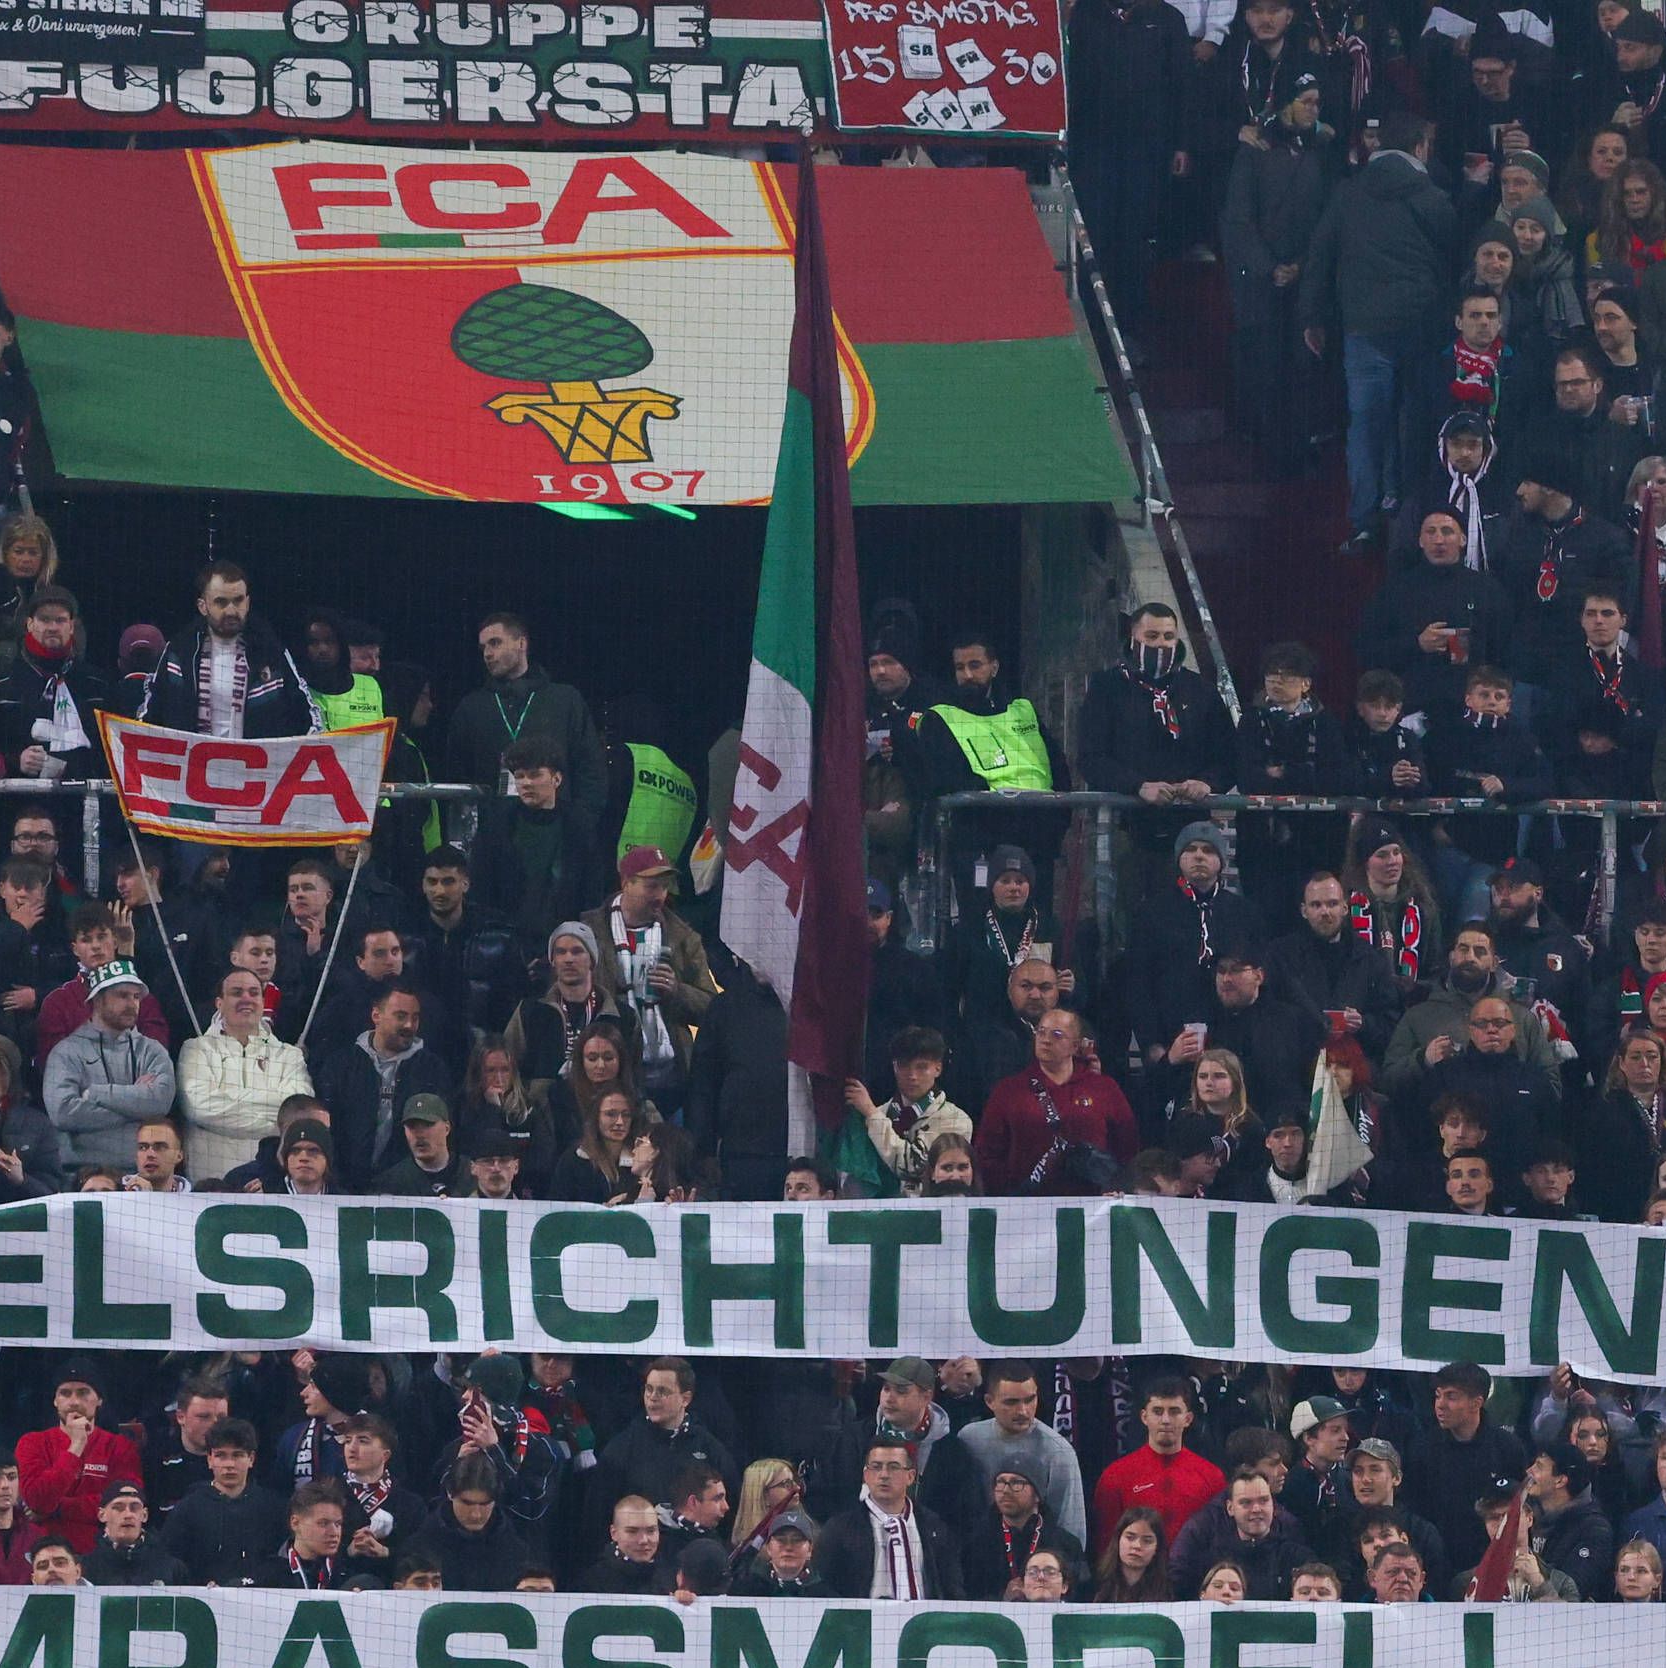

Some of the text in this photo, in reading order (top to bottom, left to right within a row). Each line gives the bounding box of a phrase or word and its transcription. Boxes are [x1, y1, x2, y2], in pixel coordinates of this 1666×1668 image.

[12, 16, 23, 31] &
[28, 15, 63, 34] Dani
[64, 18, 143, 39] unvergessen!
[293, 2, 713, 50] GRUPPE
[838, 45, 895, 84] 15
[270, 155, 733, 244] FCA
[121, 733, 369, 825] FCA
